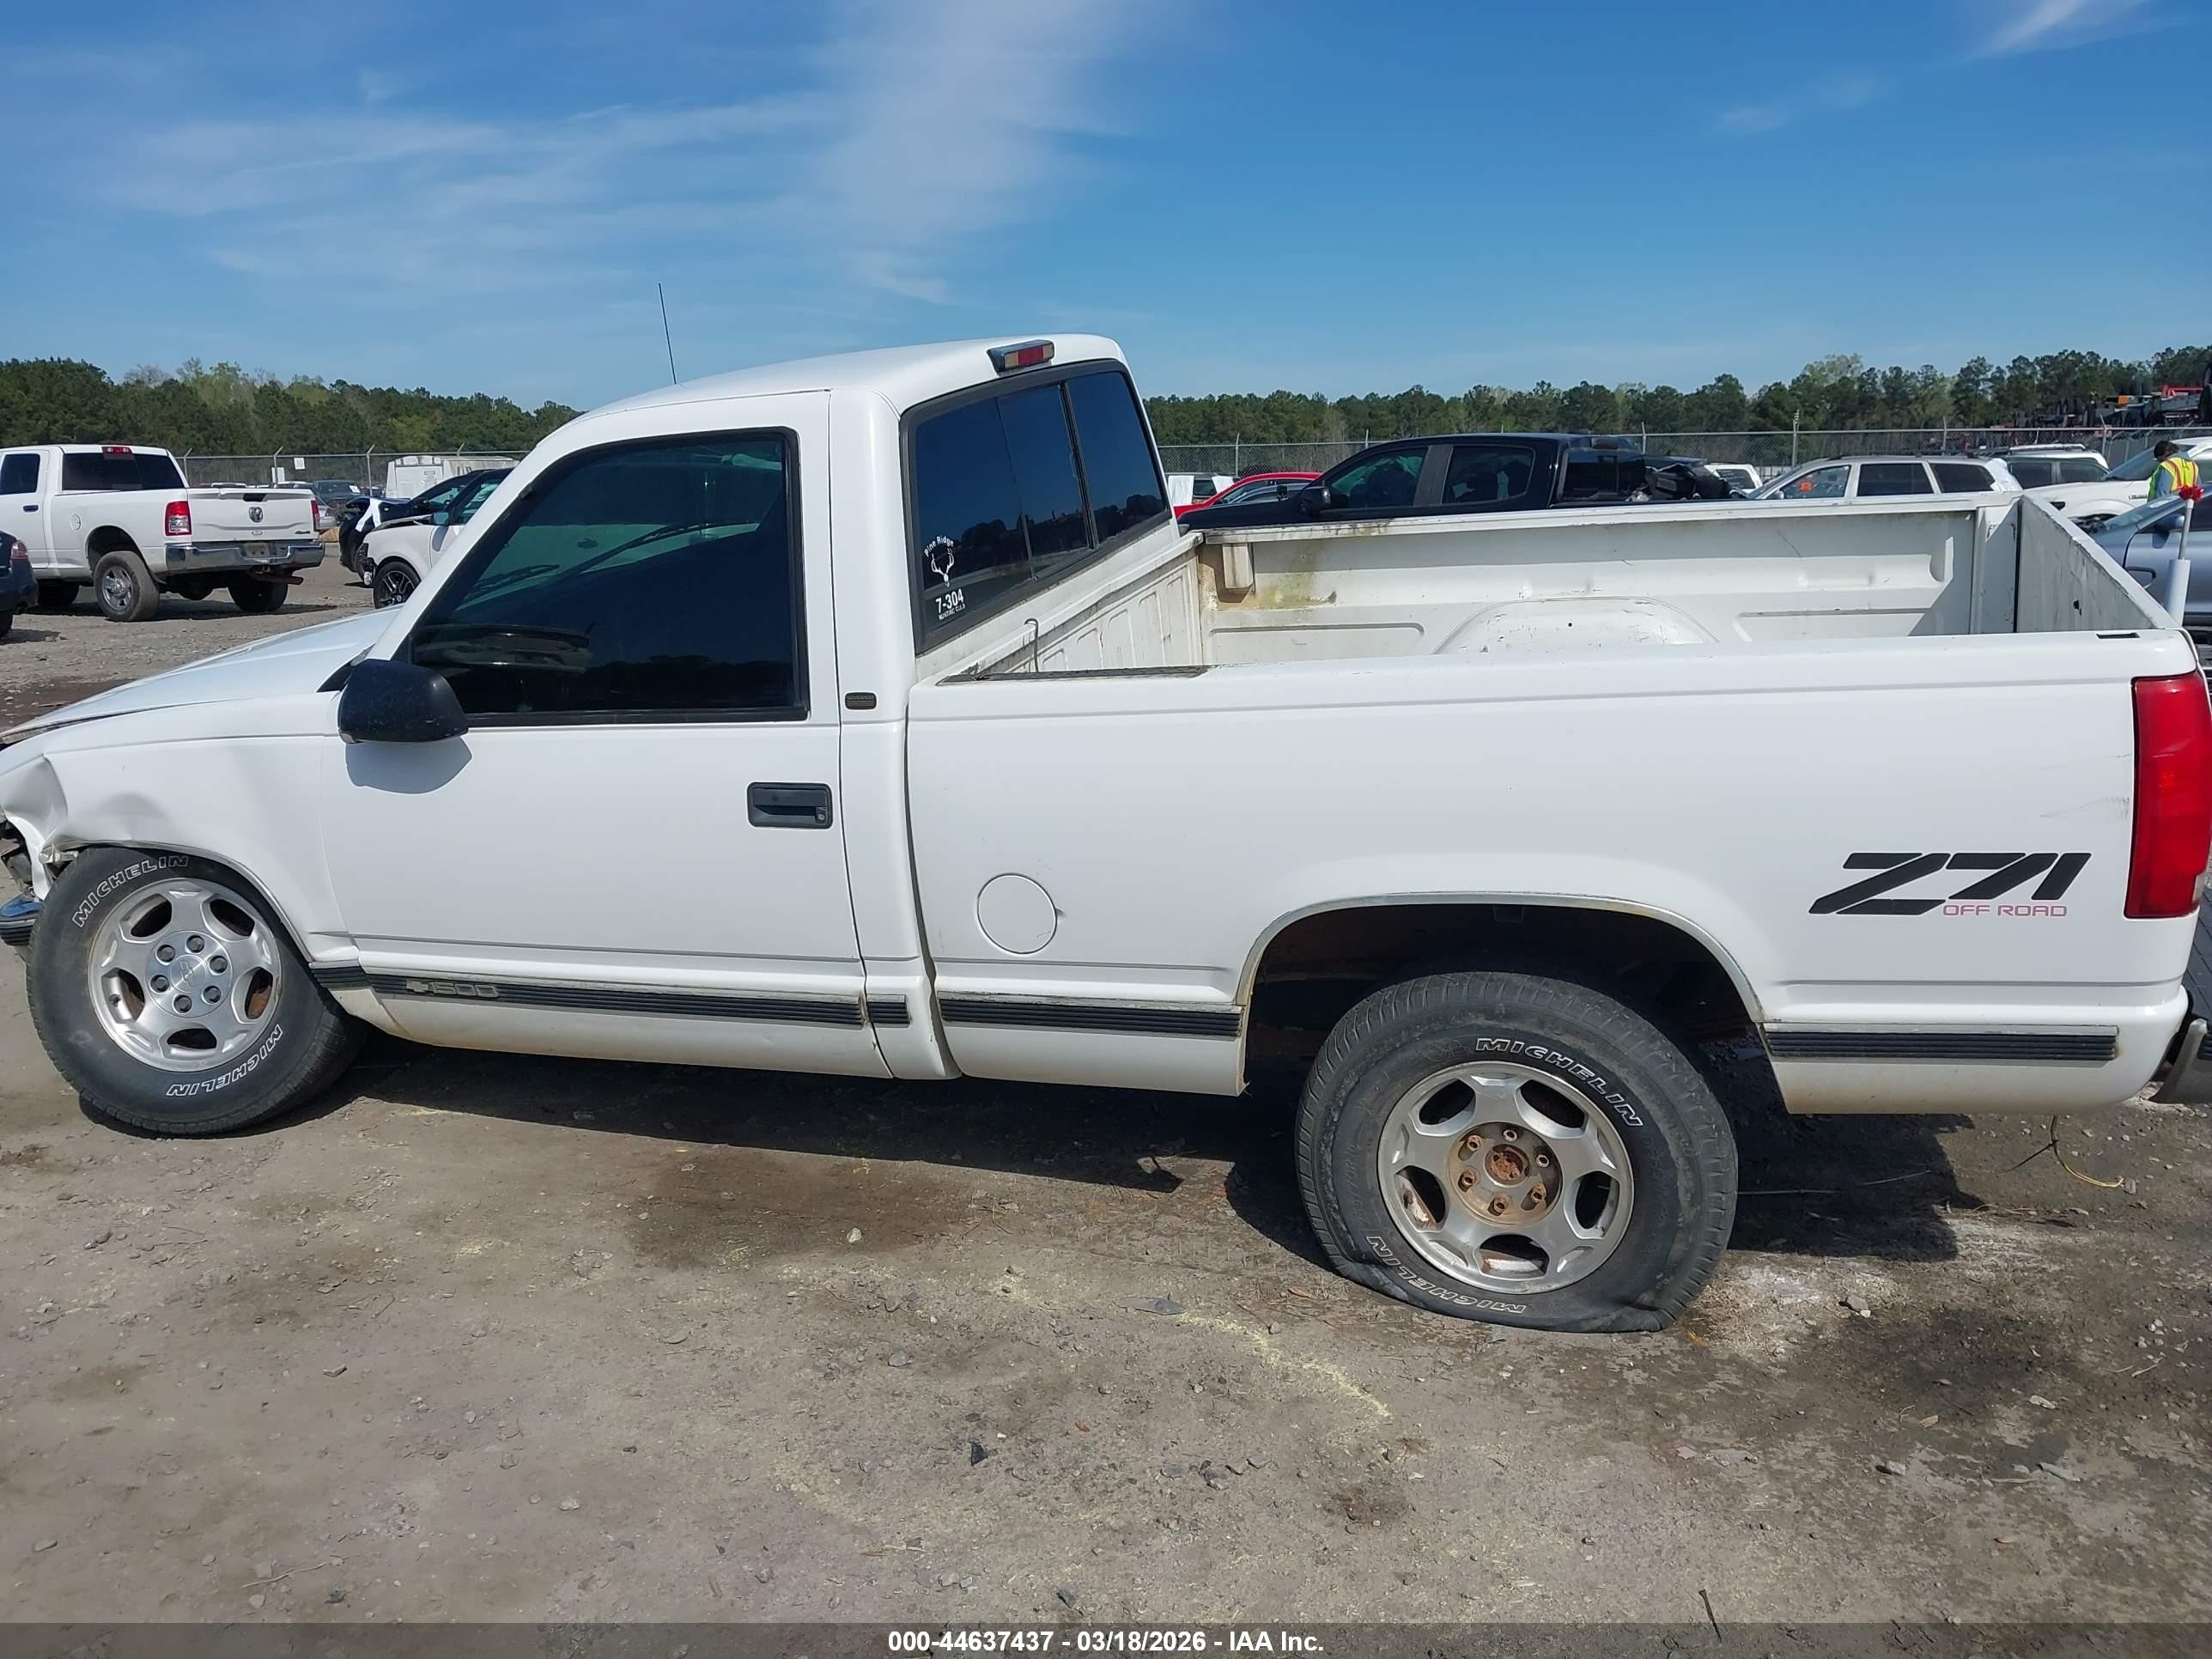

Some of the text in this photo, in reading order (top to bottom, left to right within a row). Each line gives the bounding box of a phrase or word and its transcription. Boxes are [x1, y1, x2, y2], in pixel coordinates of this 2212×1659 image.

[924, 535, 954, 557] Pine Ridge
[935, 588, 964, 614] 7-304
[71, 854, 190, 928] MICHELIN
[1808, 852, 2092, 915] Z71
[1942, 904, 2068, 917] OFF ROAD
[165, 1023, 283, 1097] MICHELIN
[1475, 1037, 1644, 1127] MICHELIN
[1365, 1235, 1526, 1315] MICHELIN
